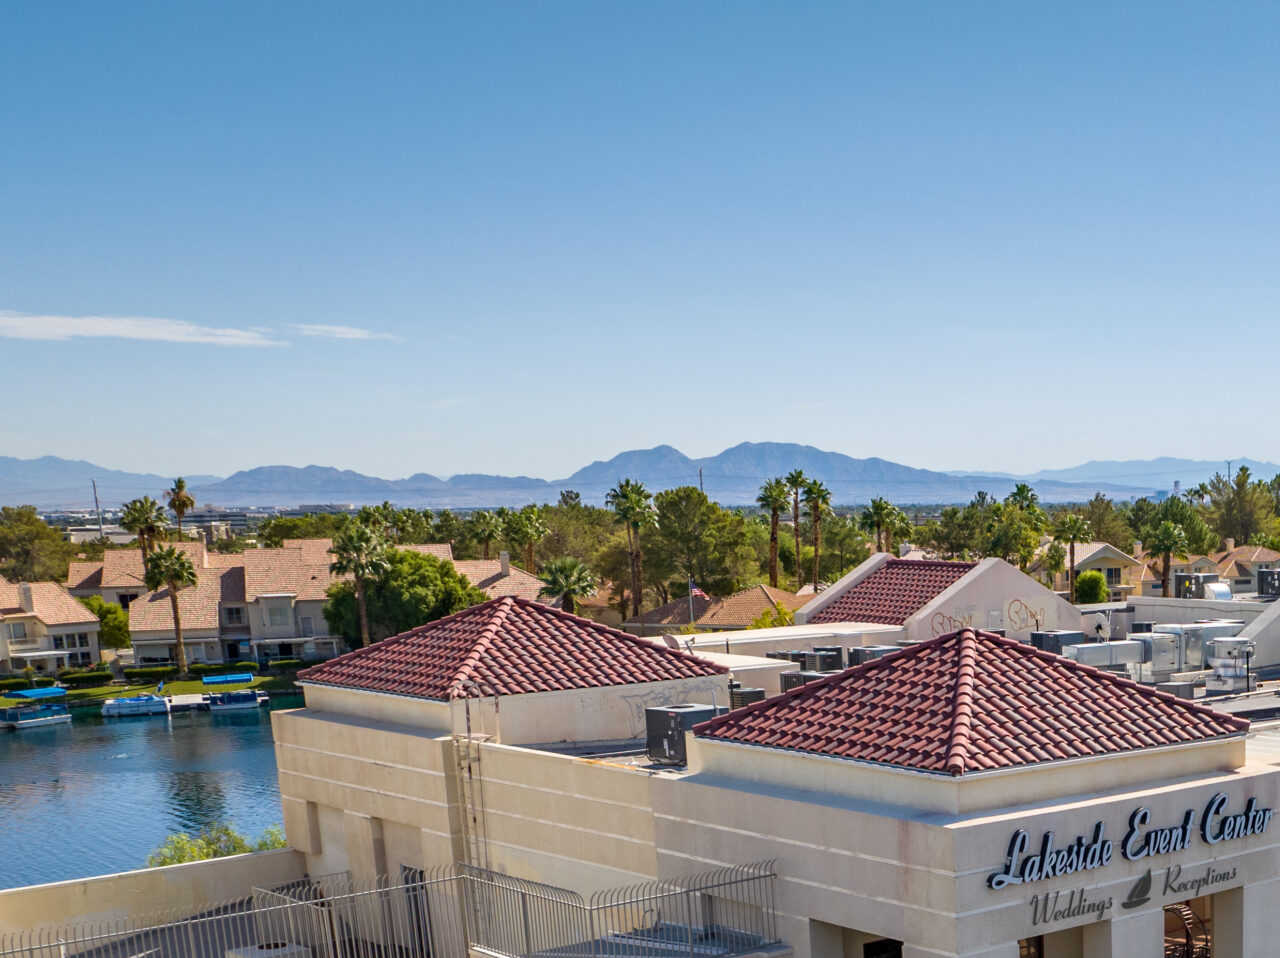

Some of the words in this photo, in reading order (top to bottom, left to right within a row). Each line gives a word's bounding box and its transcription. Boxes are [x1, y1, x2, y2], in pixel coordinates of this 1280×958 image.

[986, 828, 1113, 890] Lakeside
[1121, 806, 1196, 861] Event
[1200, 791, 1275, 845] Center
[1031, 887, 1113, 926] Weddings
[1162, 863, 1238, 896] Receptions
